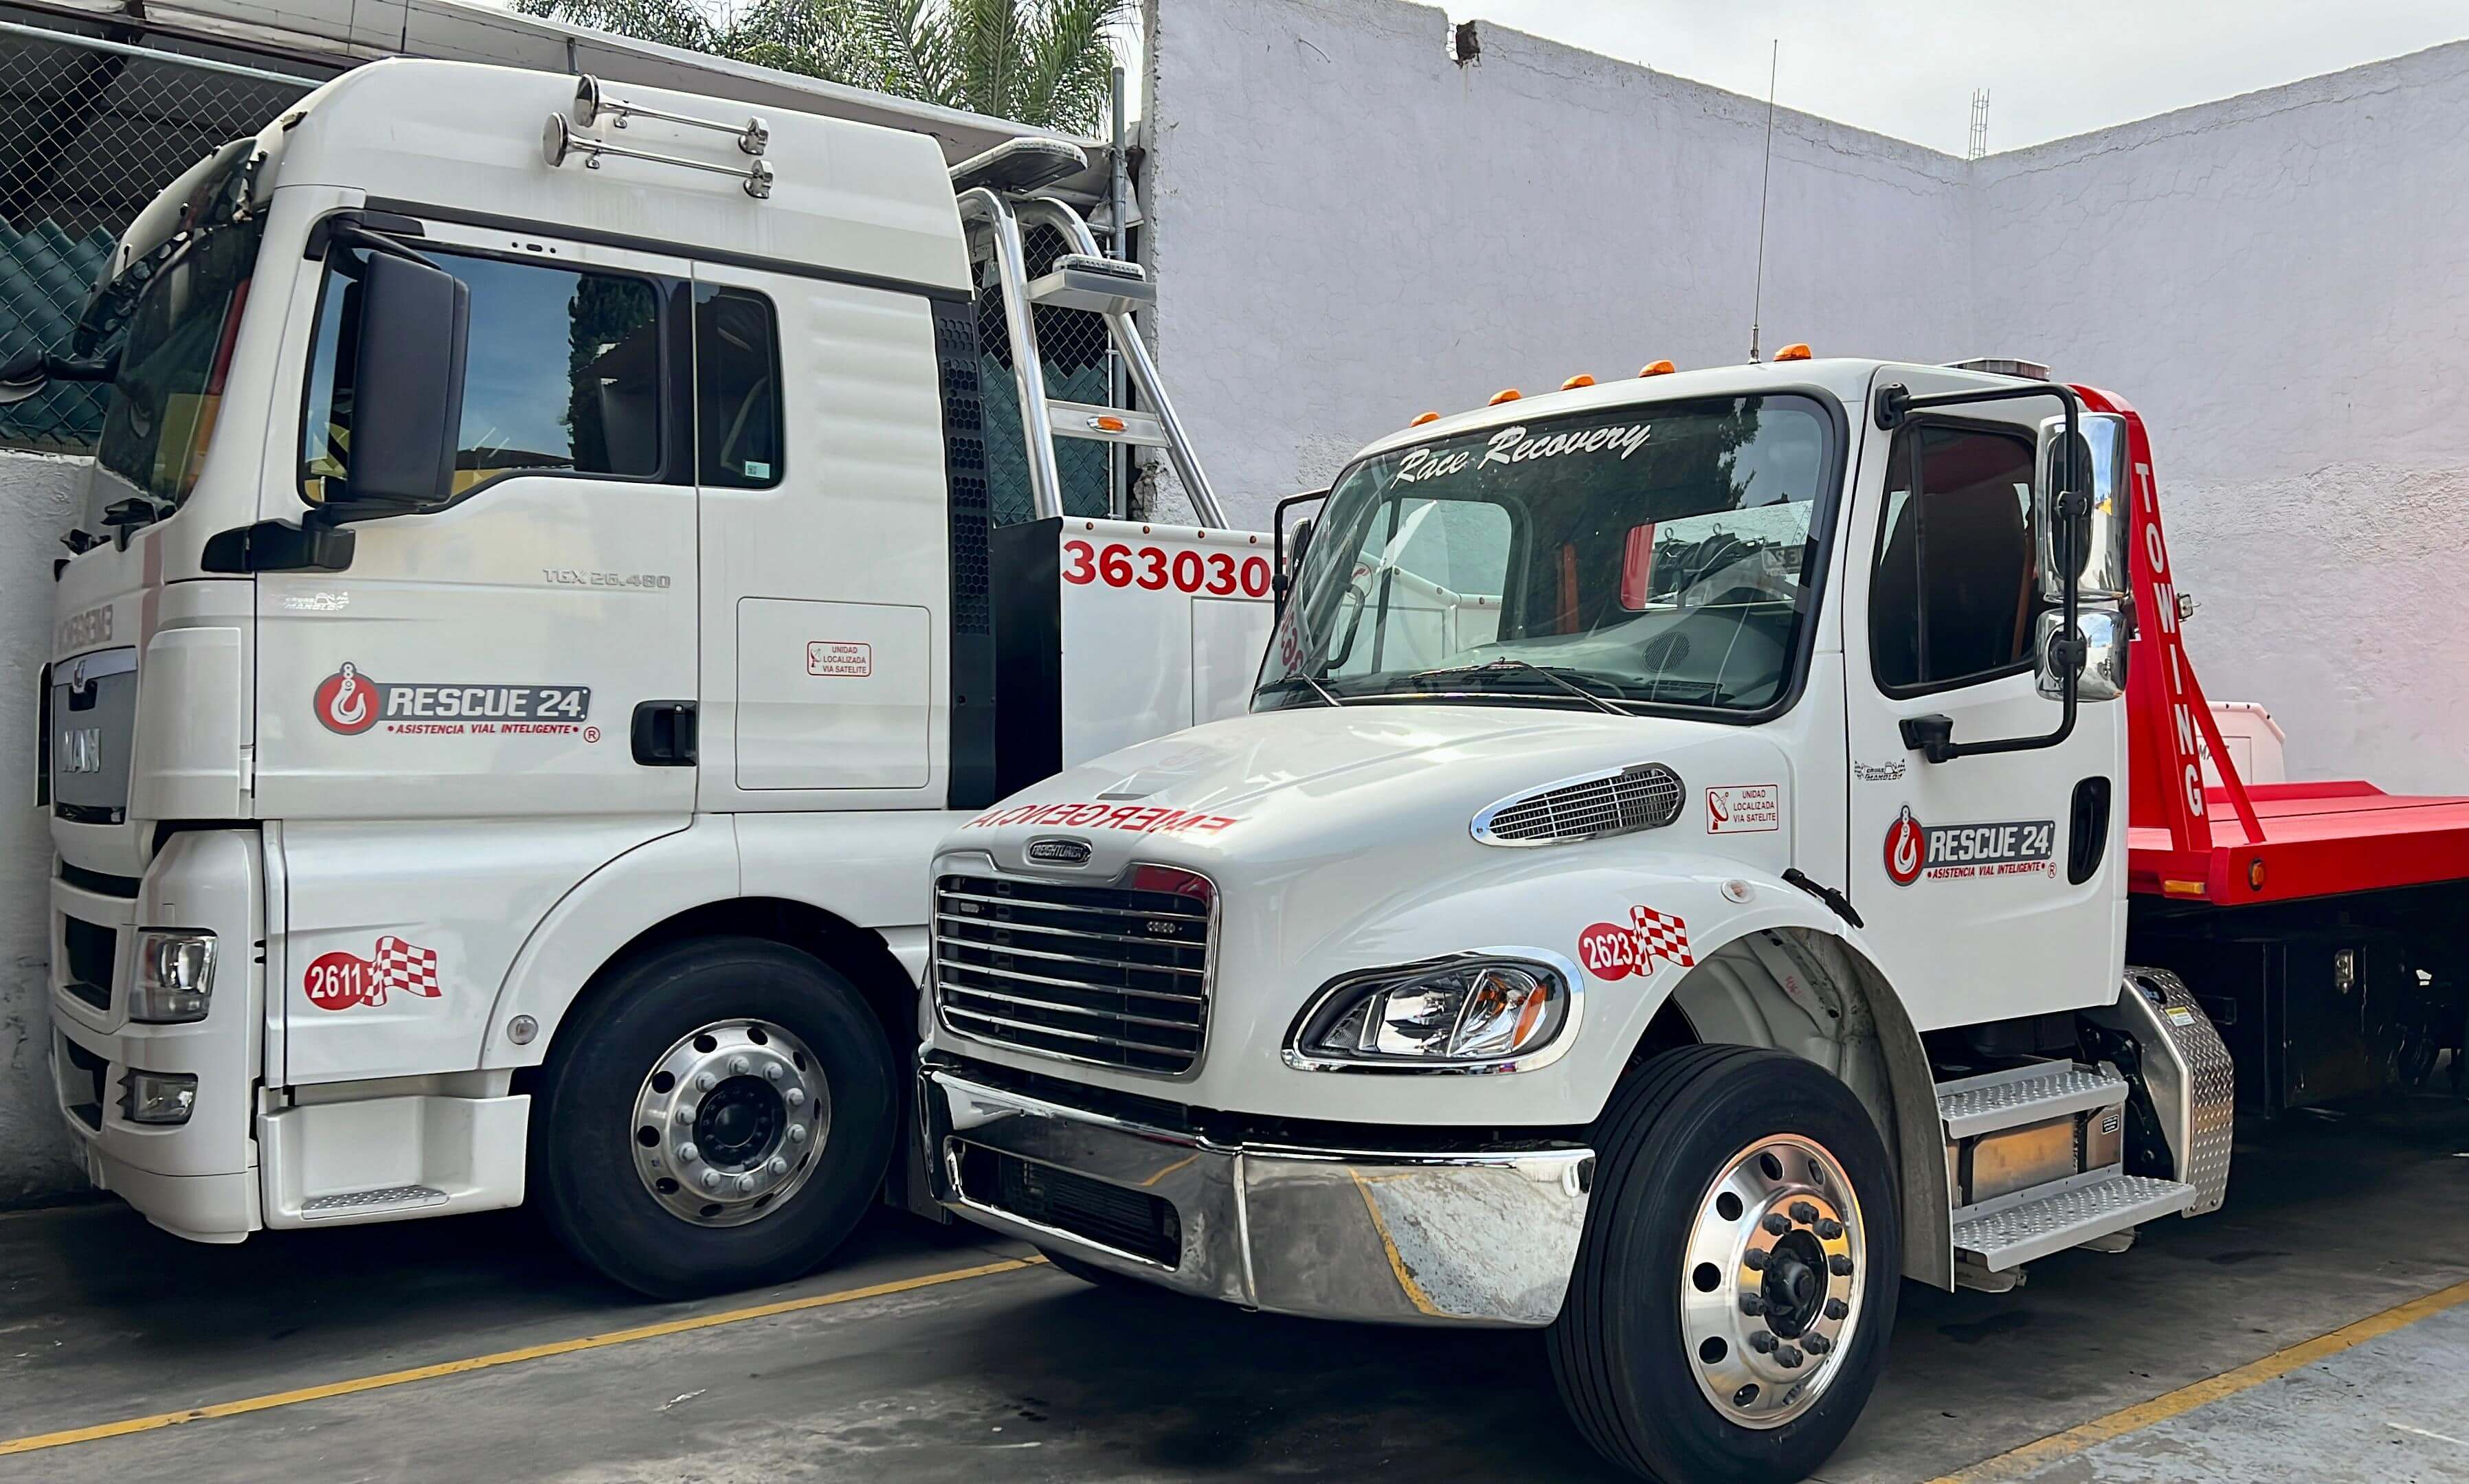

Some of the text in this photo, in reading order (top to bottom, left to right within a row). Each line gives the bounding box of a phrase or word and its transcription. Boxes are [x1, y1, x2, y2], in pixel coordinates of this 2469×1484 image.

[1389, 424, 1651, 490] Race Recovery
[543, 569, 671, 588] TGX 26.480
[1062, 540, 1287, 597] 363030
[2136, 462, 2203, 817] TOWING
[823, 655, 866, 664] LOCALIZADA
[388, 688, 581, 717] RESCUE 24
[396, 724, 571, 734] ASISTENCIA VIAL INTELIGENTE
[1742, 789, 1765, 798] UNIDAD
[1733, 801, 1774, 811] LOCALIZADA
[1733, 813, 1776, 822] VIA SATELITE
[1928, 825, 2048, 862] RESCUE 24
[1932, 862, 2040, 879] ASISTENCIA VIAL INTELIGENTE
[1583, 932, 1633, 969] 2623
[311, 963, 361, 998] 2611
